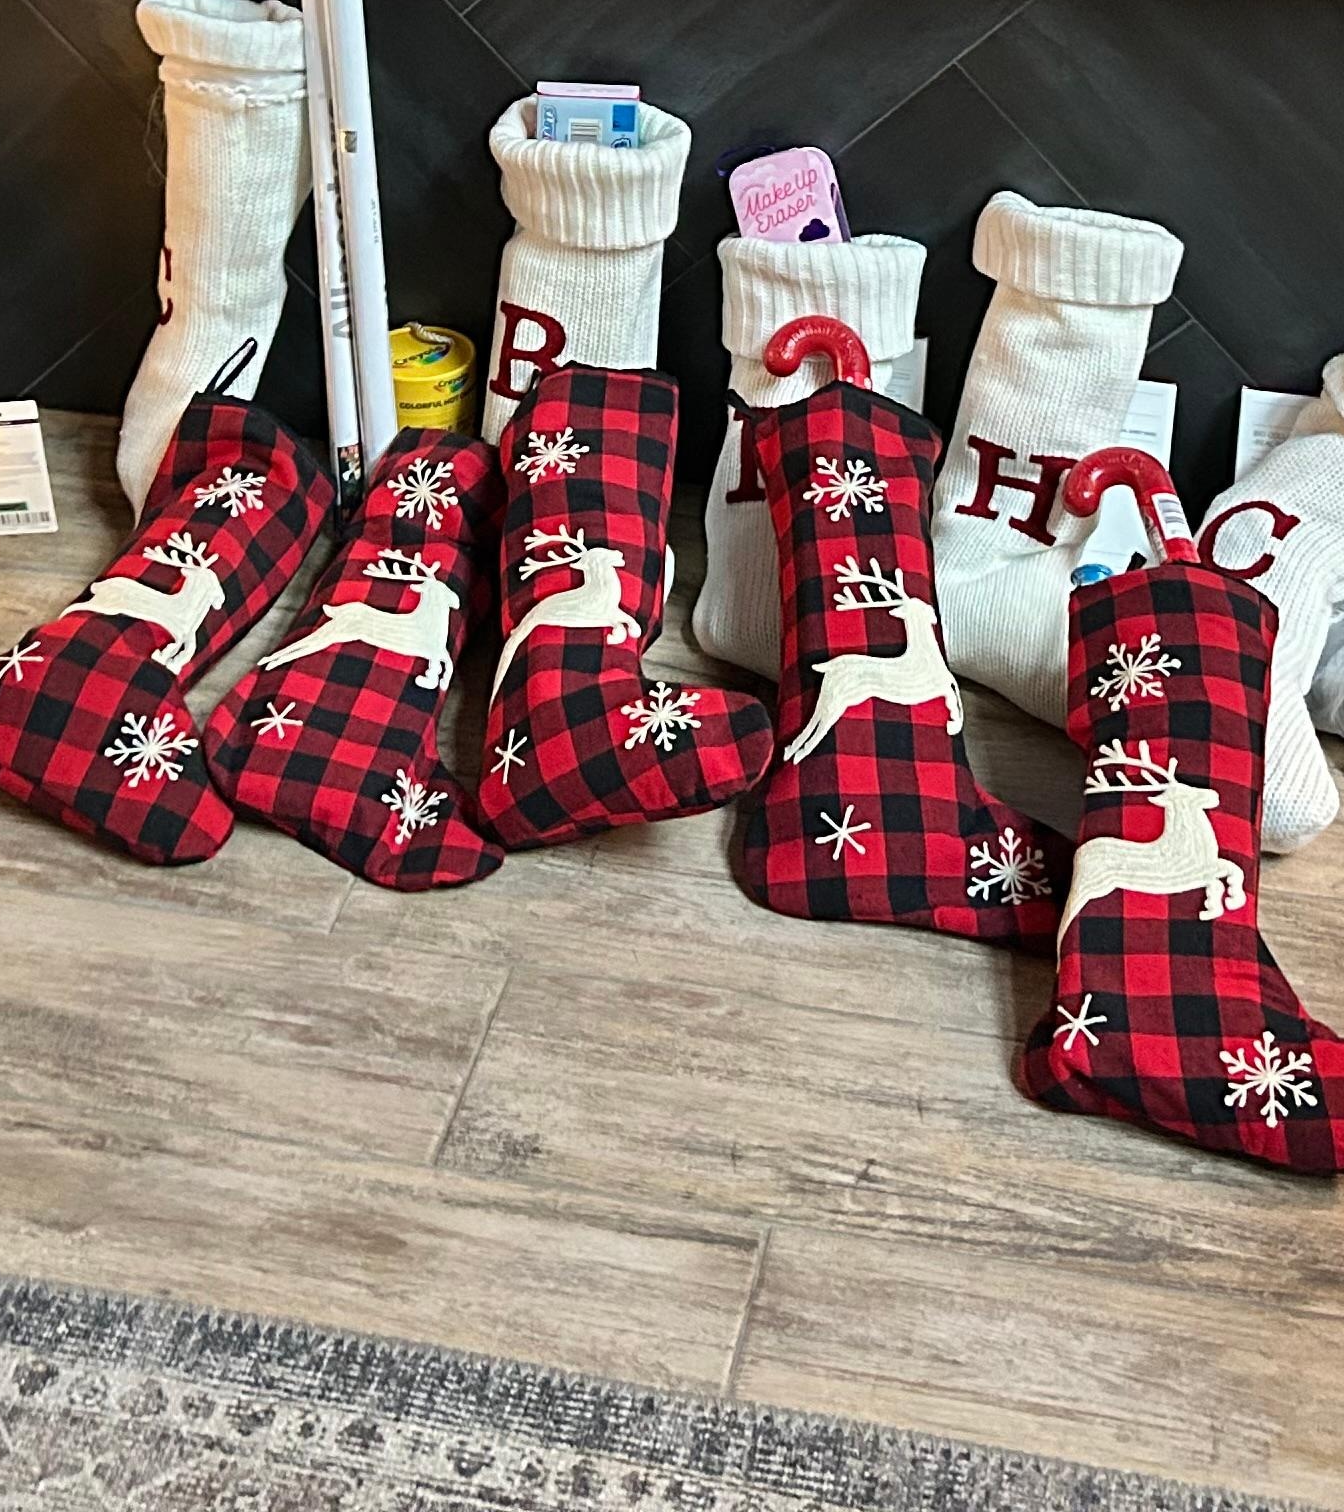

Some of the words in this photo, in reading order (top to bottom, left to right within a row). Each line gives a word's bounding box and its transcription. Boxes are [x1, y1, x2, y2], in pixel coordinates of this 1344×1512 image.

[755, 193, 816, 234] Eraser
[955, 434, 1080, 547] H
[1197, 500, 1301, 580] C
